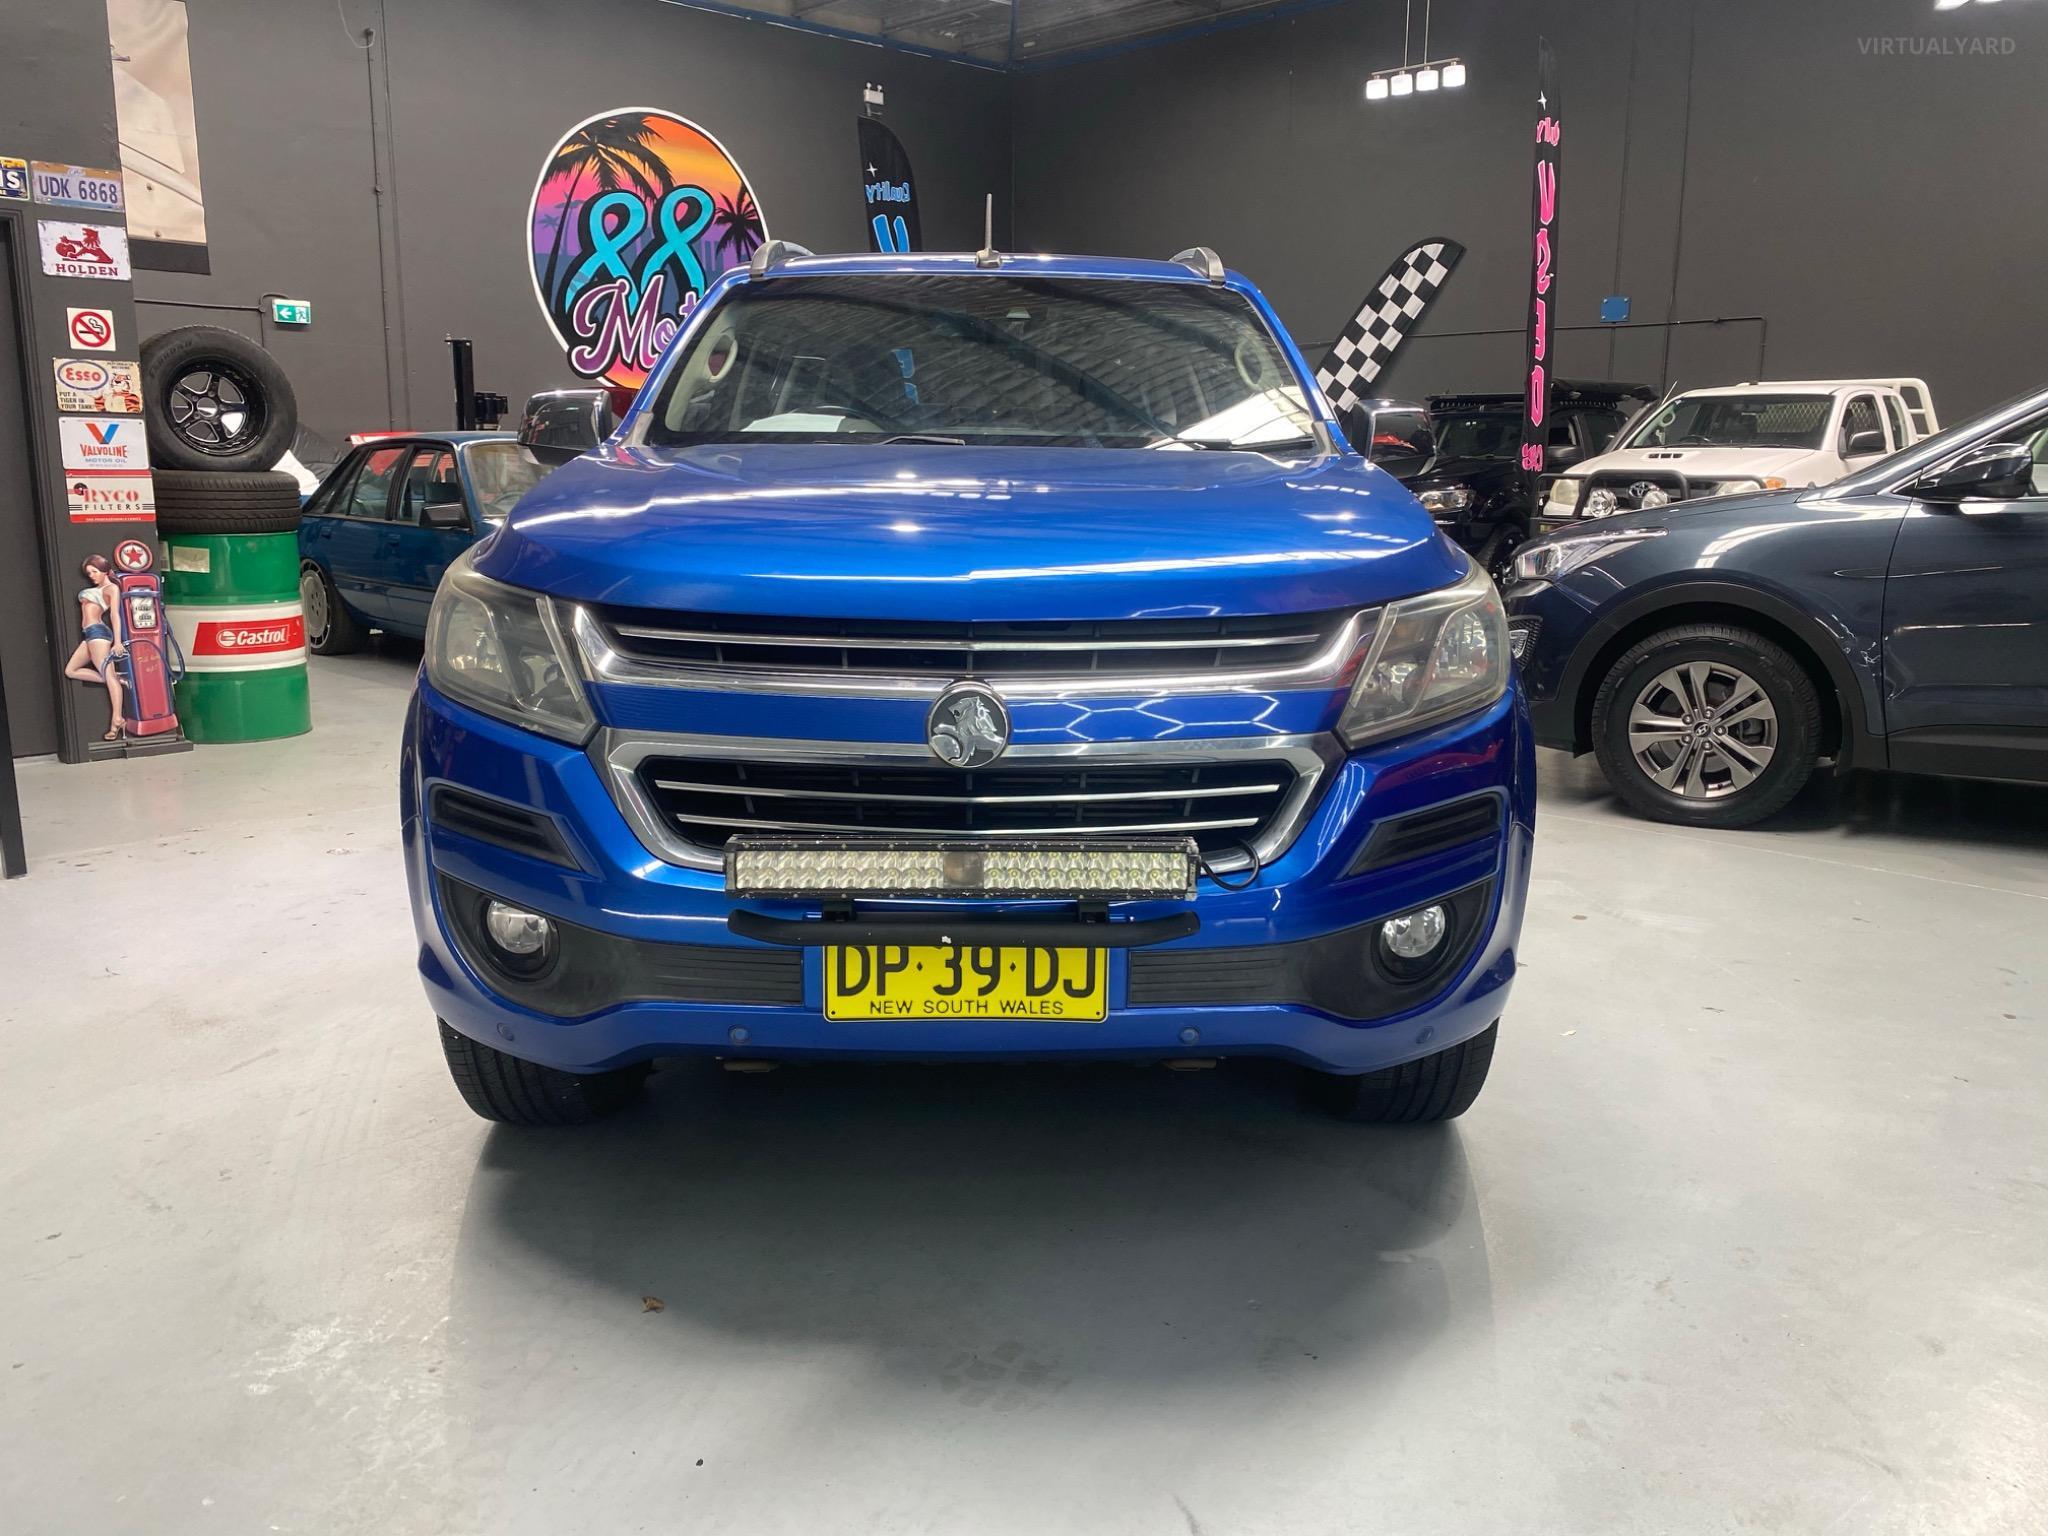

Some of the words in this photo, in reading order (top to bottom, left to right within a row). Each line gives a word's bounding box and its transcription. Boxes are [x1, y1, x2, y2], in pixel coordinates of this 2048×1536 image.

[38, 175, 71, 198] UDK
[79, 180, 118, 204] 6868
[565, 186, 716, 316] 88
[55, 263, 119, 277] HOLDEN
[80, 443, 128, 458] VALVOLINE
[83, 489, 139, 502] RYCO
[84, 503, 141, 511] FILTERS
[237, 627, 286, 646] Castrol
[869, 1000, 912, 1015] NEW
[922, 1000, 988, 1015] SOUTH
[999, 1001, 1064, 1015] WALES
